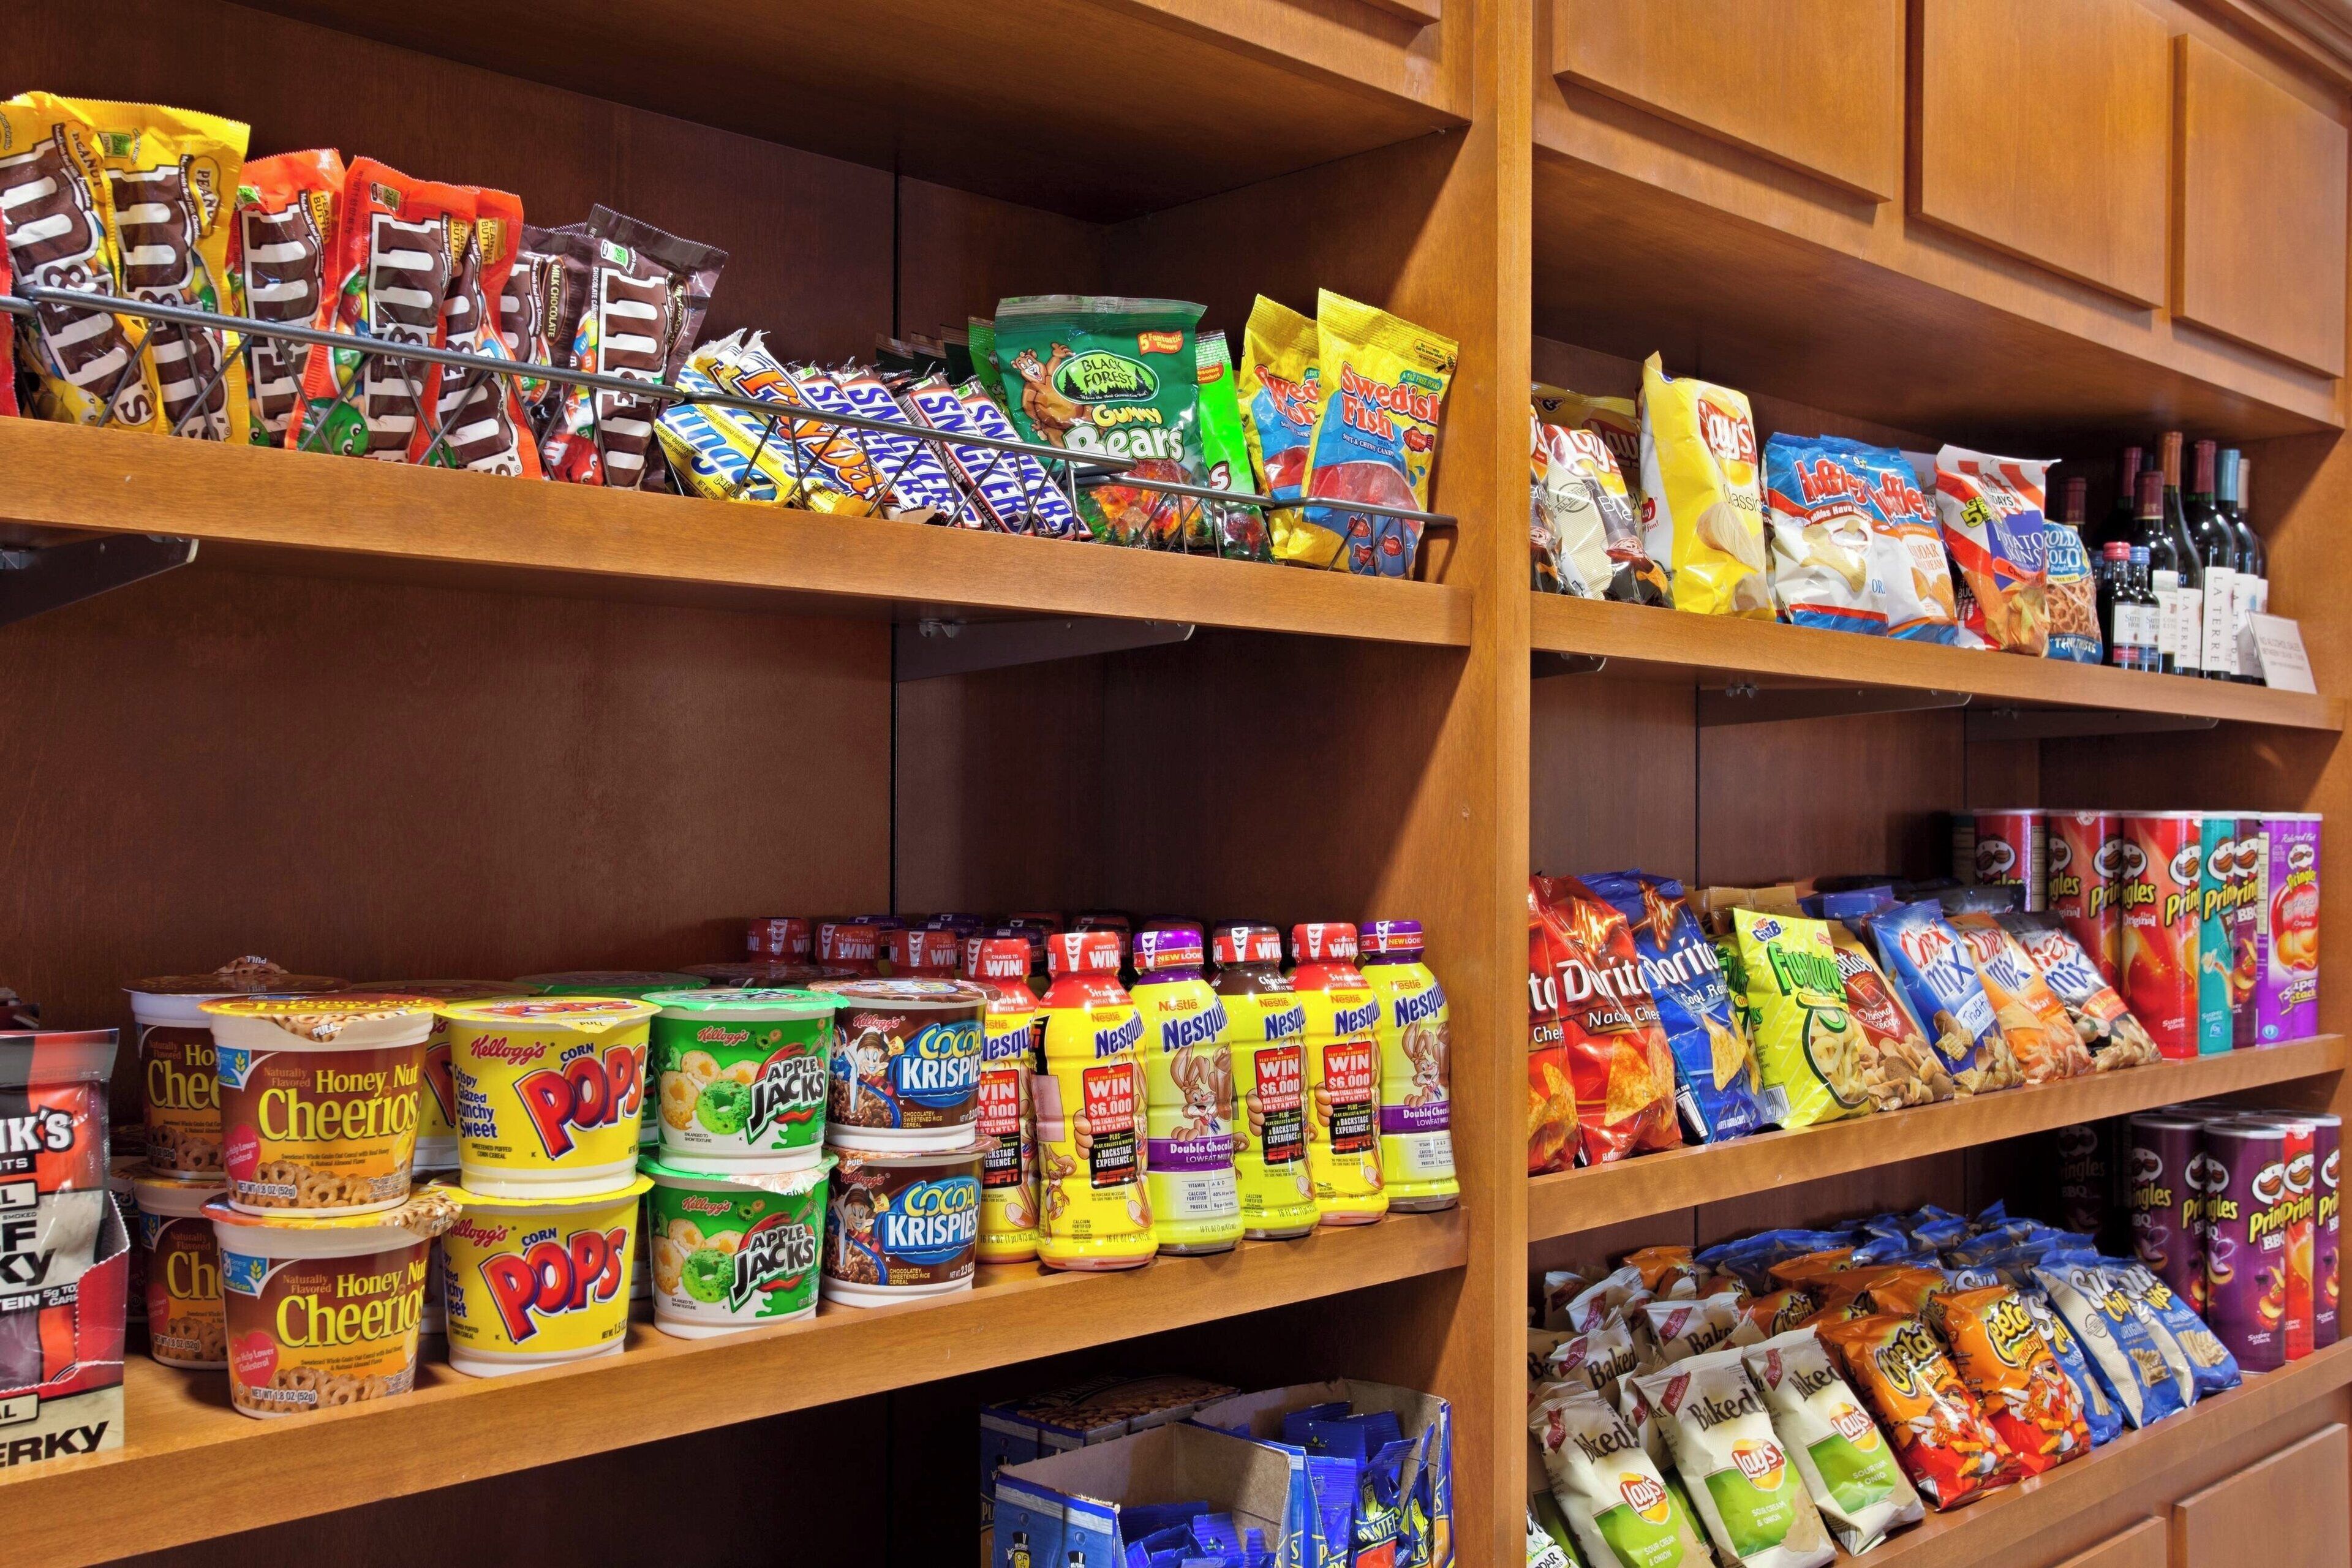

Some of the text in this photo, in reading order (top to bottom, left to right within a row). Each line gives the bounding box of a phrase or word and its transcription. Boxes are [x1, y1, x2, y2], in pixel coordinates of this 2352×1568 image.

[548, 265, 560, 337] MILK CHOCOLATE
[1140, 333, 1182, 350] 5 Fantastic
[1081, 358, 1125, 372] BLACK
[1084, 371, 1132, 388] FOREST
[1341, 361, 1441, 426] Swedish
[1341, 392, 1395, 442] Fish
[1063, 424, 1186, 464] Bears
[1359, 440, 1376, 452] CHEWY
[1832, 505, 1853, 516] Have
[1961, 507, 1983, 528] 5
[2211, 576, 2223, 663] LA TERRE
[2180, 619, 2189, 660] TERRE
[838, 942, 875, 959] WIN!
[1088, 950, 1119, 968] WIN!
[985, 959, 1023, 976] WIN!
[1390, 979, 1423, 990] Nestlé
[1158, 999, 1199, 1011] Nestlé
[1259, 997, 1291, 1008] Nestlé
[1330, 994, 1362, 1004] Nestlé
[1681, 992, 1705, 1006] Cool
[1091, 1012, 1121, 1023] Nestlé
[1588, 1009, 1632, 1028] Nacho
[1857, 1003, 1895, 1022] Original
[853, 1014, 901, 1031] Kellogg's
[697, 1026, 749, 1045] Kellogg's
[918, 1025, 982, 1060] COCOA
[471, 1034, 546, 1065] Kellogg's
[560, 1042, 594, 1062] CORN
[767, 1056, 818, 1082] APPLE
[1259, 1058, 1299, 1079] WIN
[1328, 1053, 1370, 1072] WIN
[263, 1068, 307, 1079] Naturally
[272, 1077, 311, 1087] Flavored
[316, 1063, 419, 1095] Honey Nut
[454, 1063, 478, 1088] Crispy
[1329, 1073, 1370, 1090] $6,000
[1088, 1076, 1131, 1098] WIN
[1261, 1079, 1299, 1096] $6,000
[458, 1090, 487, 1104] Glazed
[513, 1043, 646, 1160] POPS
[1264, 1100, 1299, 1110] INSTANTLY
[1332, 1094, 1370, 1102] INSTANTLY
[258, 1088, 419, 1142] Cheerios
[748, 1072, 825, 1142] JACKS
[1090, 1098, 1132, 1118] $6,000
[1403, 1107, 1430, 1118] Double
[461, 1120, 498, 1138] Sweet
[1093, 1120, 1132, 1133] INSTANTLY
[1272, 1123, 1299, 1134] BACKSTAGE
[1340, 1115, 1369, 1126] BACKSTAGE
[1417, 1118, 1440, 1126] LOWFAT
[1335, 1126, 1366, 1134] EXPERIENCE
[1267, 1134, 1298, 1144] EXPERIENCE
[1101, 1145, 1132, 1157] BACKSTAGE
[1170, 1143, 1205, 1154] Double
[1096, 1156, 1129, 1168] EXPERIENCE
[840, 1170, 886, 1189] Kellogg's
[682, 1196, 732, 1215] Kellogg's
[904, 1183, 976, 1218] COCOA
[888, 1204, 979, 1247] KRISPIES
[521, 1227, 557, 1247] CORN
[750, 1223, 805, 1252] APPLE
[283, 1275, 328, 1284] Naturally
[336, 1259, 427, 1298] Honey Nut
[731, 1236, 815, 1310] JACKS
[291, 1283, 332, 1294] Flavored
[478, 1226, 630, 1345] POPS
[276, 1285, 425, 1348] Cheerios
[254, 1348, 274, 1358] Lower
[264, 1388, 274, 1399] WT
[274, 1389, 284, 1400] 1.8
[285, 1389, 296, 1401] OZ
[296, 1390, 317, 1404] (52g)
[1832, 1410, 1869, 1441] Lay's
[1737, 1443, 1778, 1480] Lay's
[1643, 1544, 1659, 1556] SOUR
[1653, 1549, 1672, 1563] ONION
